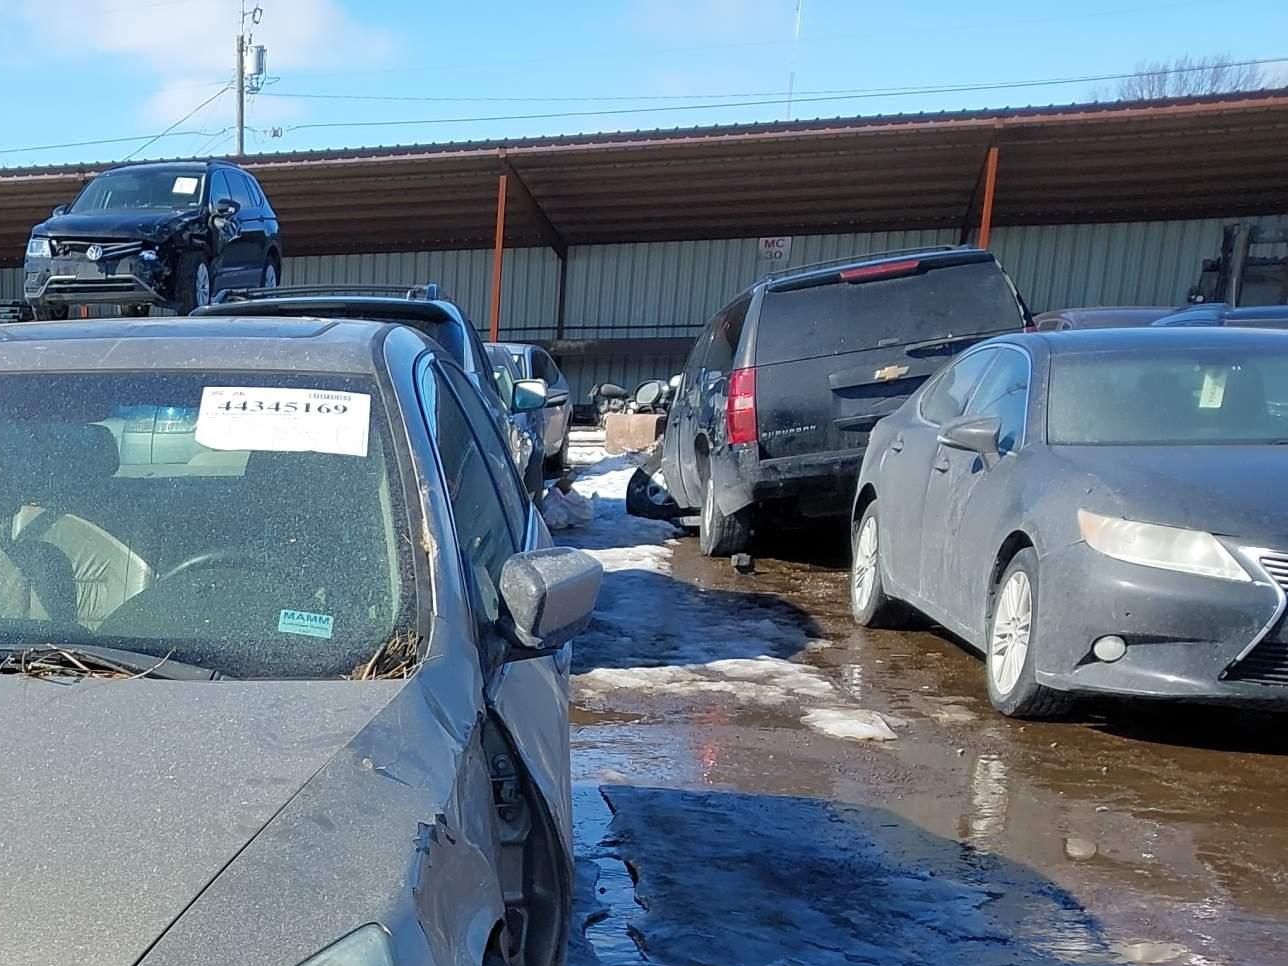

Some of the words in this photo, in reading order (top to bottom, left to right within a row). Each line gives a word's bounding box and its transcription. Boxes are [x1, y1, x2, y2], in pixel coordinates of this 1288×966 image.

[764, 238, 785, 249] MC
[765, 250, 783, 260] 30
[217, 399, 348, 415] 44345169
[761, 425, 816, 438] SUBURBAN
[283, 611, 330, 625] MAMM
